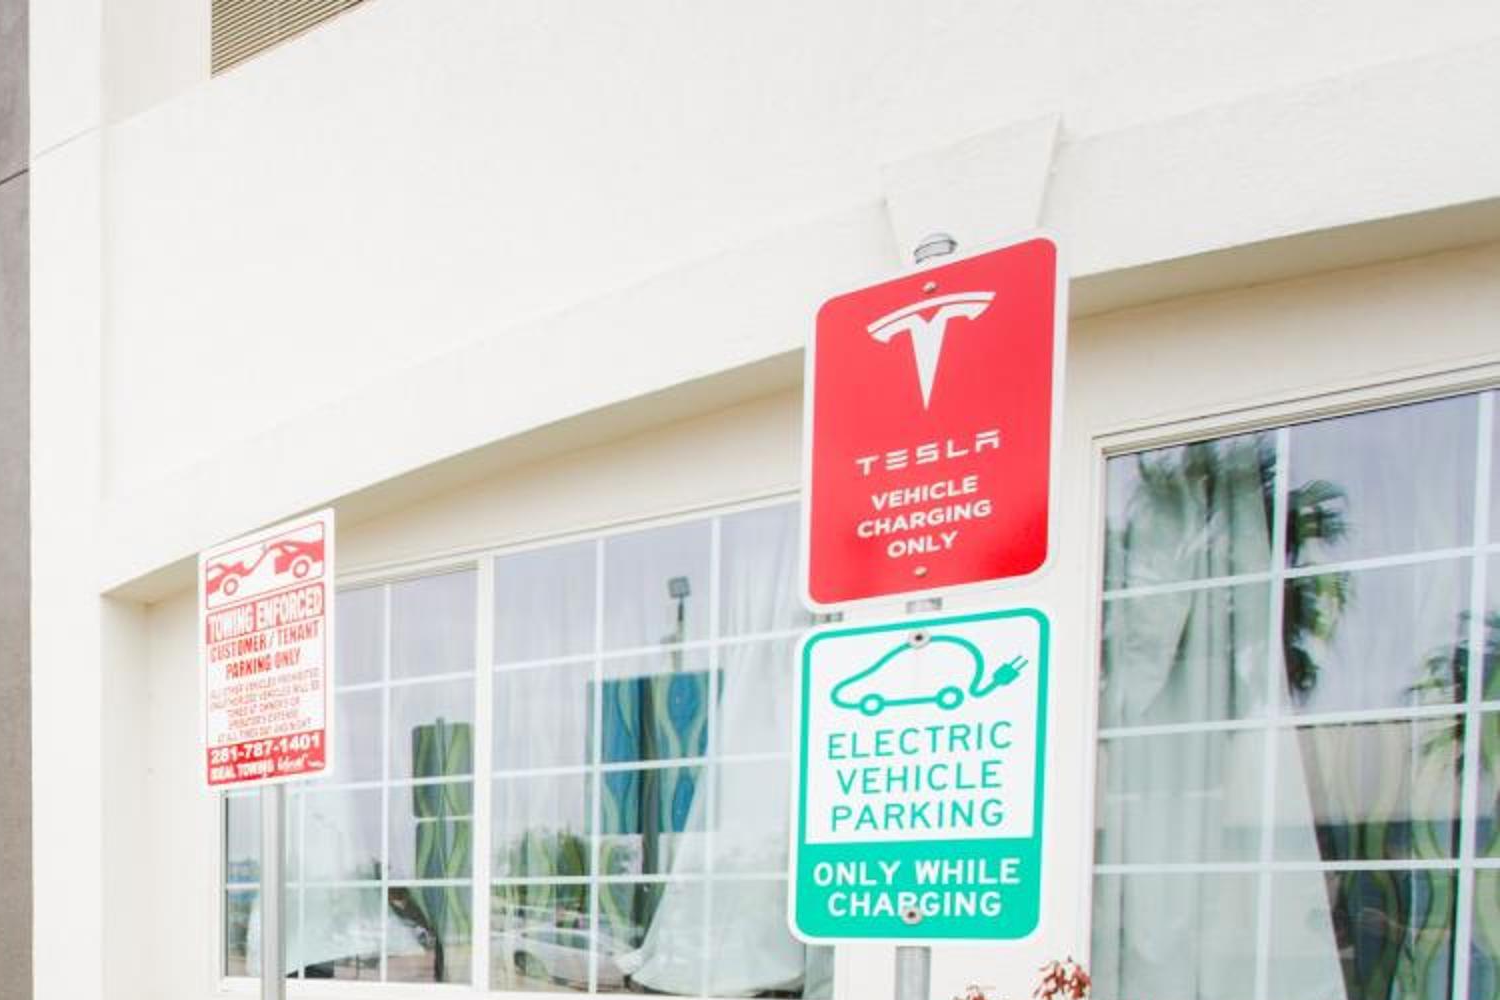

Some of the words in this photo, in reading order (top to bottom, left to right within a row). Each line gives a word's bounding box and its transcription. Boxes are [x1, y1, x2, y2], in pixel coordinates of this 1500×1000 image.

[855, 429, 1001, 476] TESLA
[871, 475, 978, 512] VEHICLE
[857, 499, 992, 538] CHARGING
[887, 530, 958, 558] ONLY
[209, 605, 254, 642] TOWING
[256, 587, 323, 629] ENFORCED
[210, 632, 267, 662] CUSTOMER
[276, 620, 320, 646] TENANT
[226, 653, 272, 679] PARKING
[275, 647, 301, 669] ONLY
[828, 721, 1012, 760] ELECTRIC
[836, 760, 1003, 795] VEHICLE
[831, 799, 1004, 832] PARKING
[813, 860, 901, 886] ONLY
[914, 857, 1021, 885] WHILE
[828, 891, 1002, 917] CHARGING
